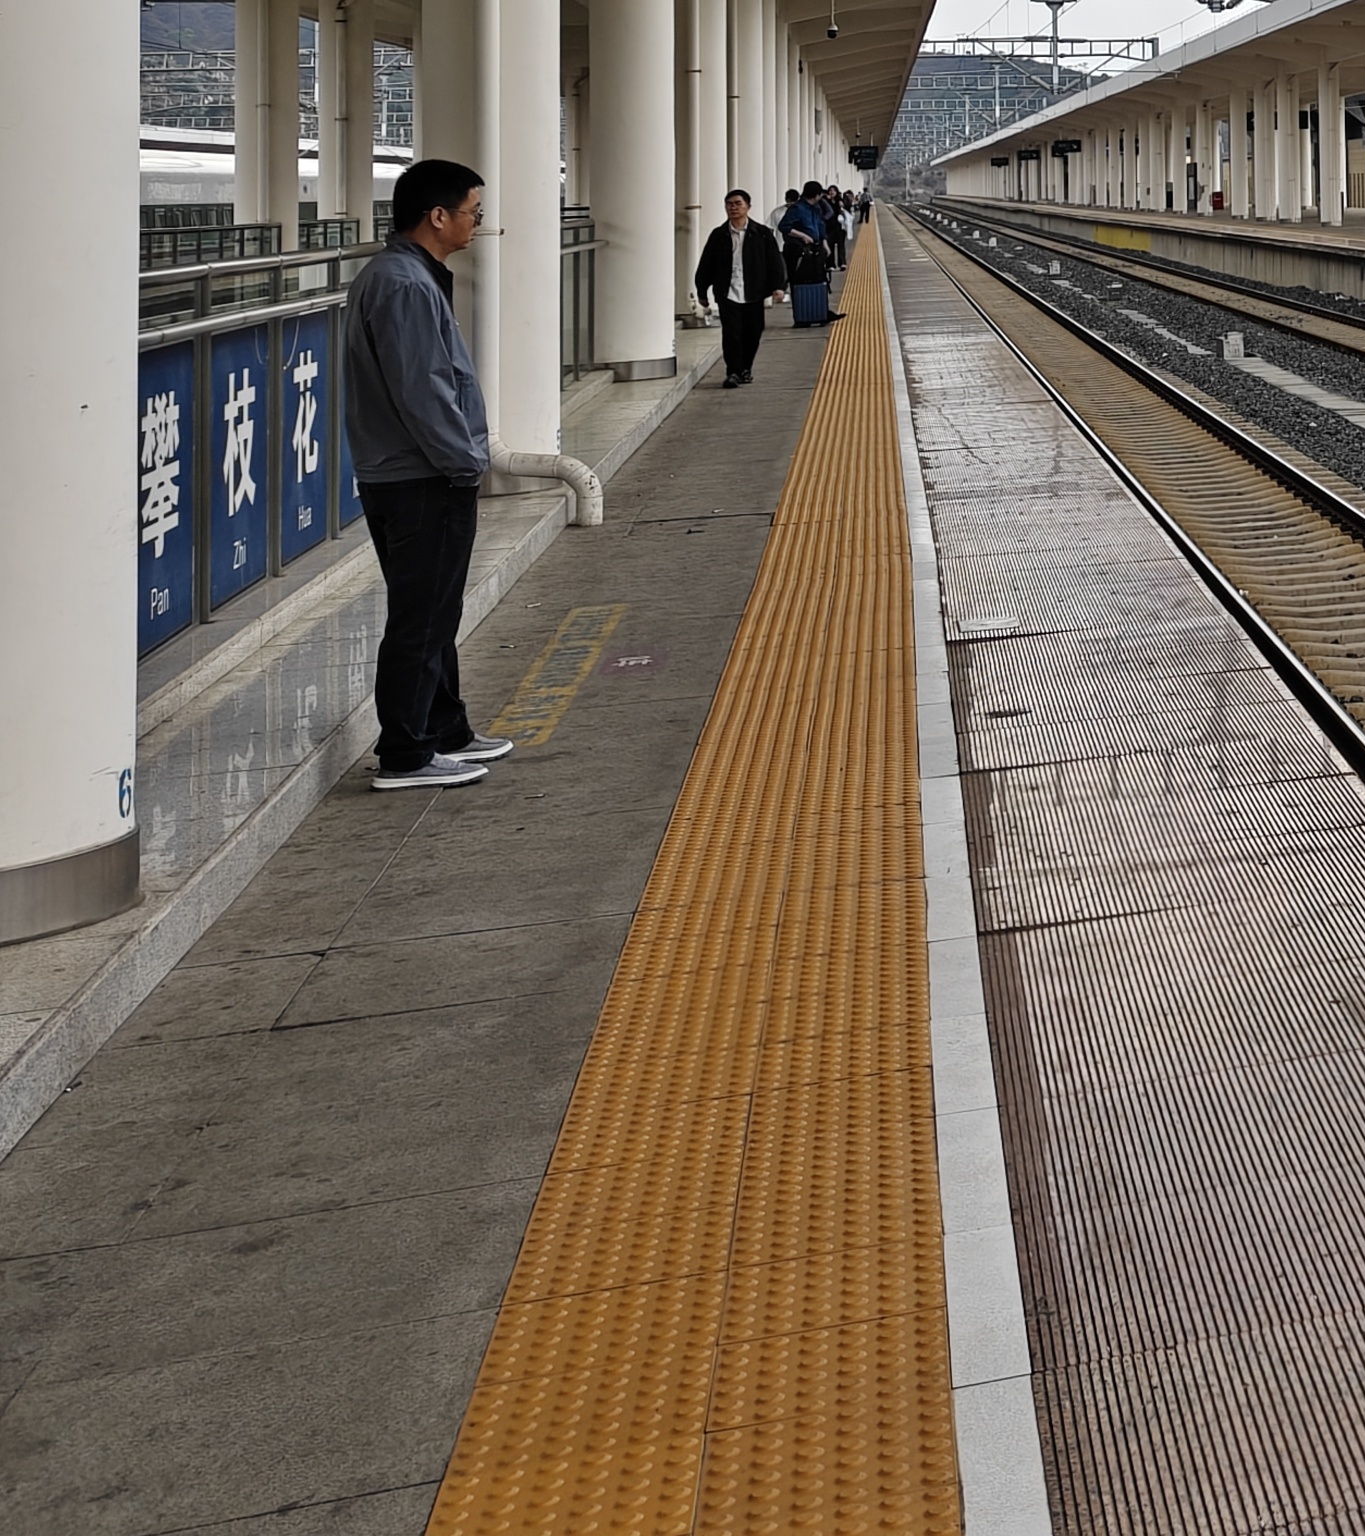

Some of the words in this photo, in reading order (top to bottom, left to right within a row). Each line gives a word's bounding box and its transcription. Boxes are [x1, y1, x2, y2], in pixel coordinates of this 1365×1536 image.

[223, 367, 257, 518] 枝
[292, 349, 319, 484] 花
[150, 587, 170, 621] Pan
[233, 536, 247, 571] Zhi
[298, 505, 313, 532] Hua
